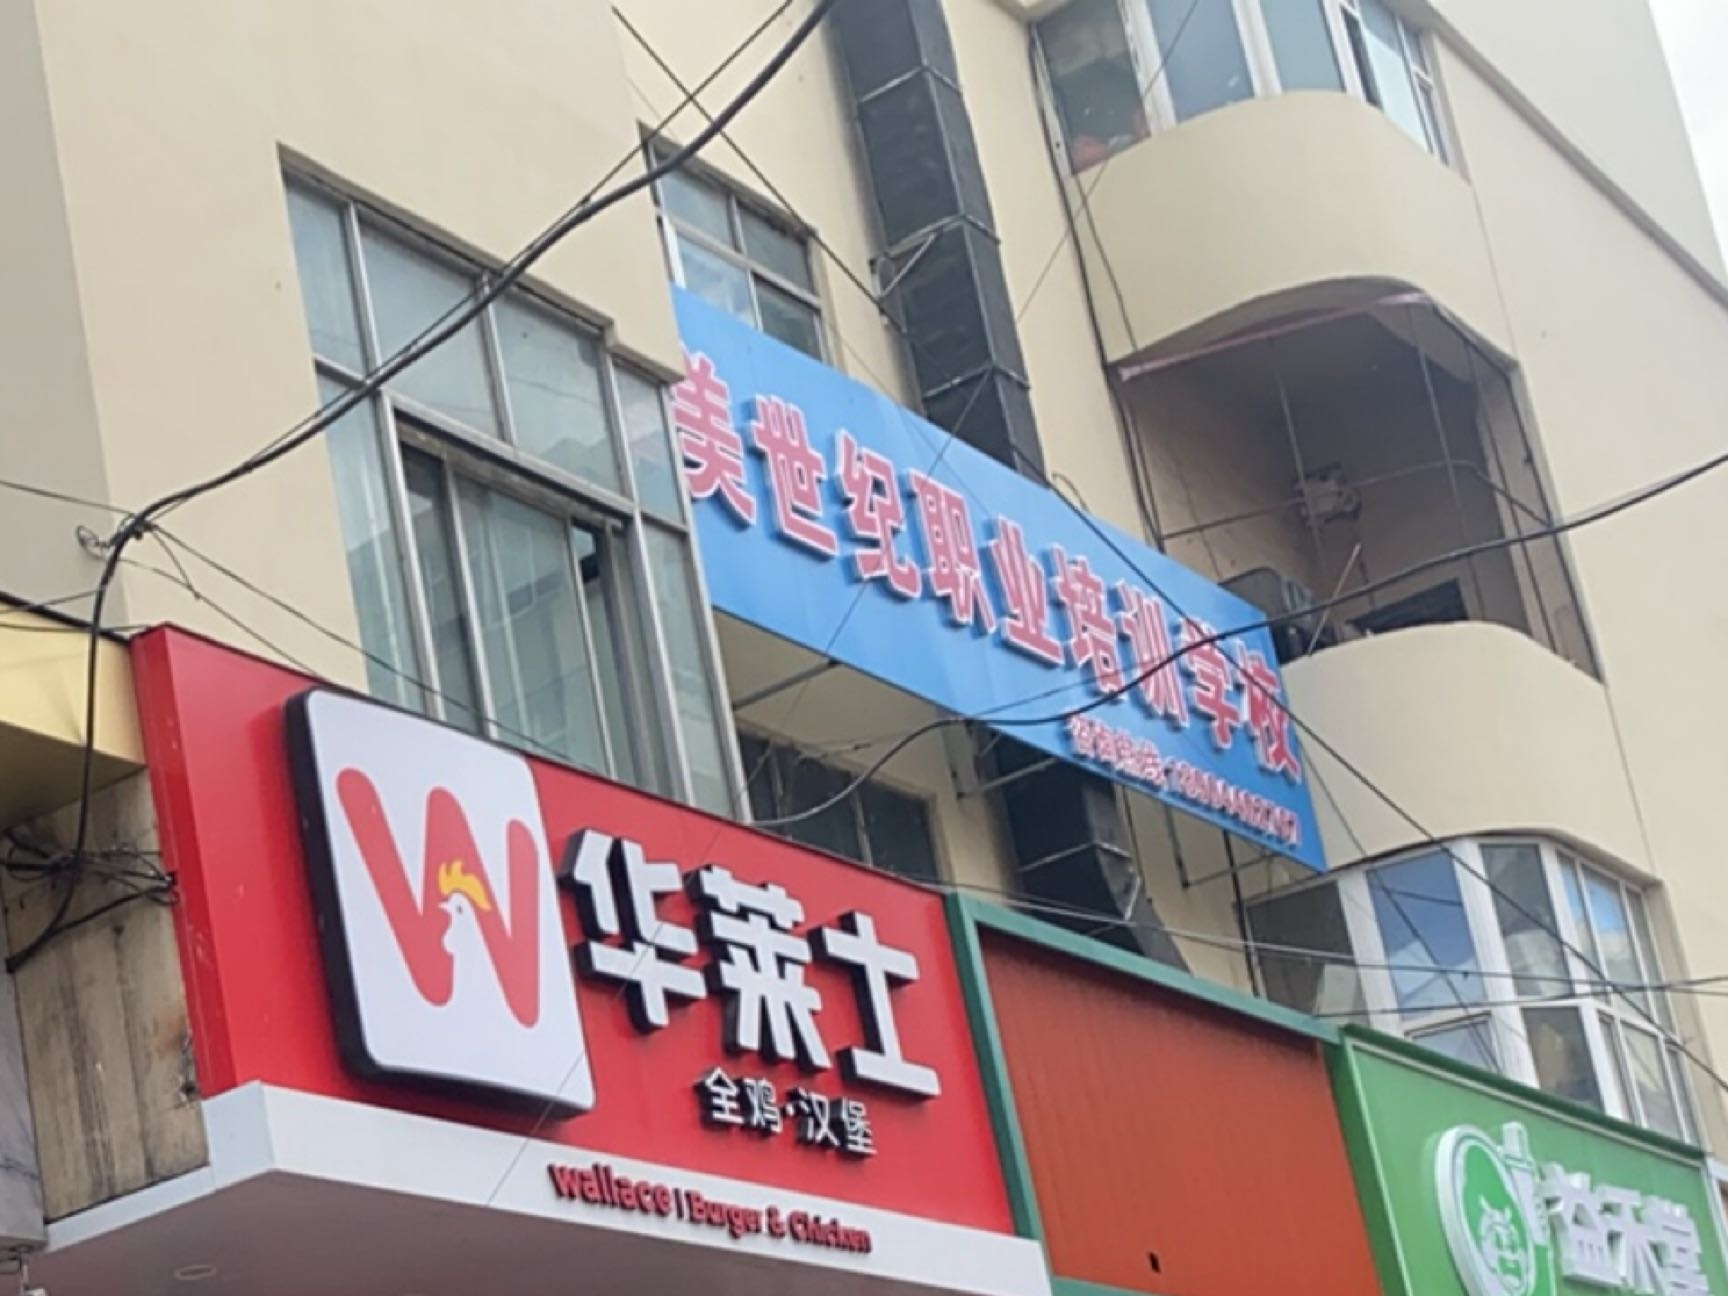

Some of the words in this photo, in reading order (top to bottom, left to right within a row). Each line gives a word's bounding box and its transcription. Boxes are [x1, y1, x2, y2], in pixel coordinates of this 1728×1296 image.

[673, 340, 1301, 784] 美世纪职业培训学校
[559, 827, 940, 1099] 华莱士
[684, 1190, 763, 1239] Burger
[788, 1210, 872, 1253] Chicken
